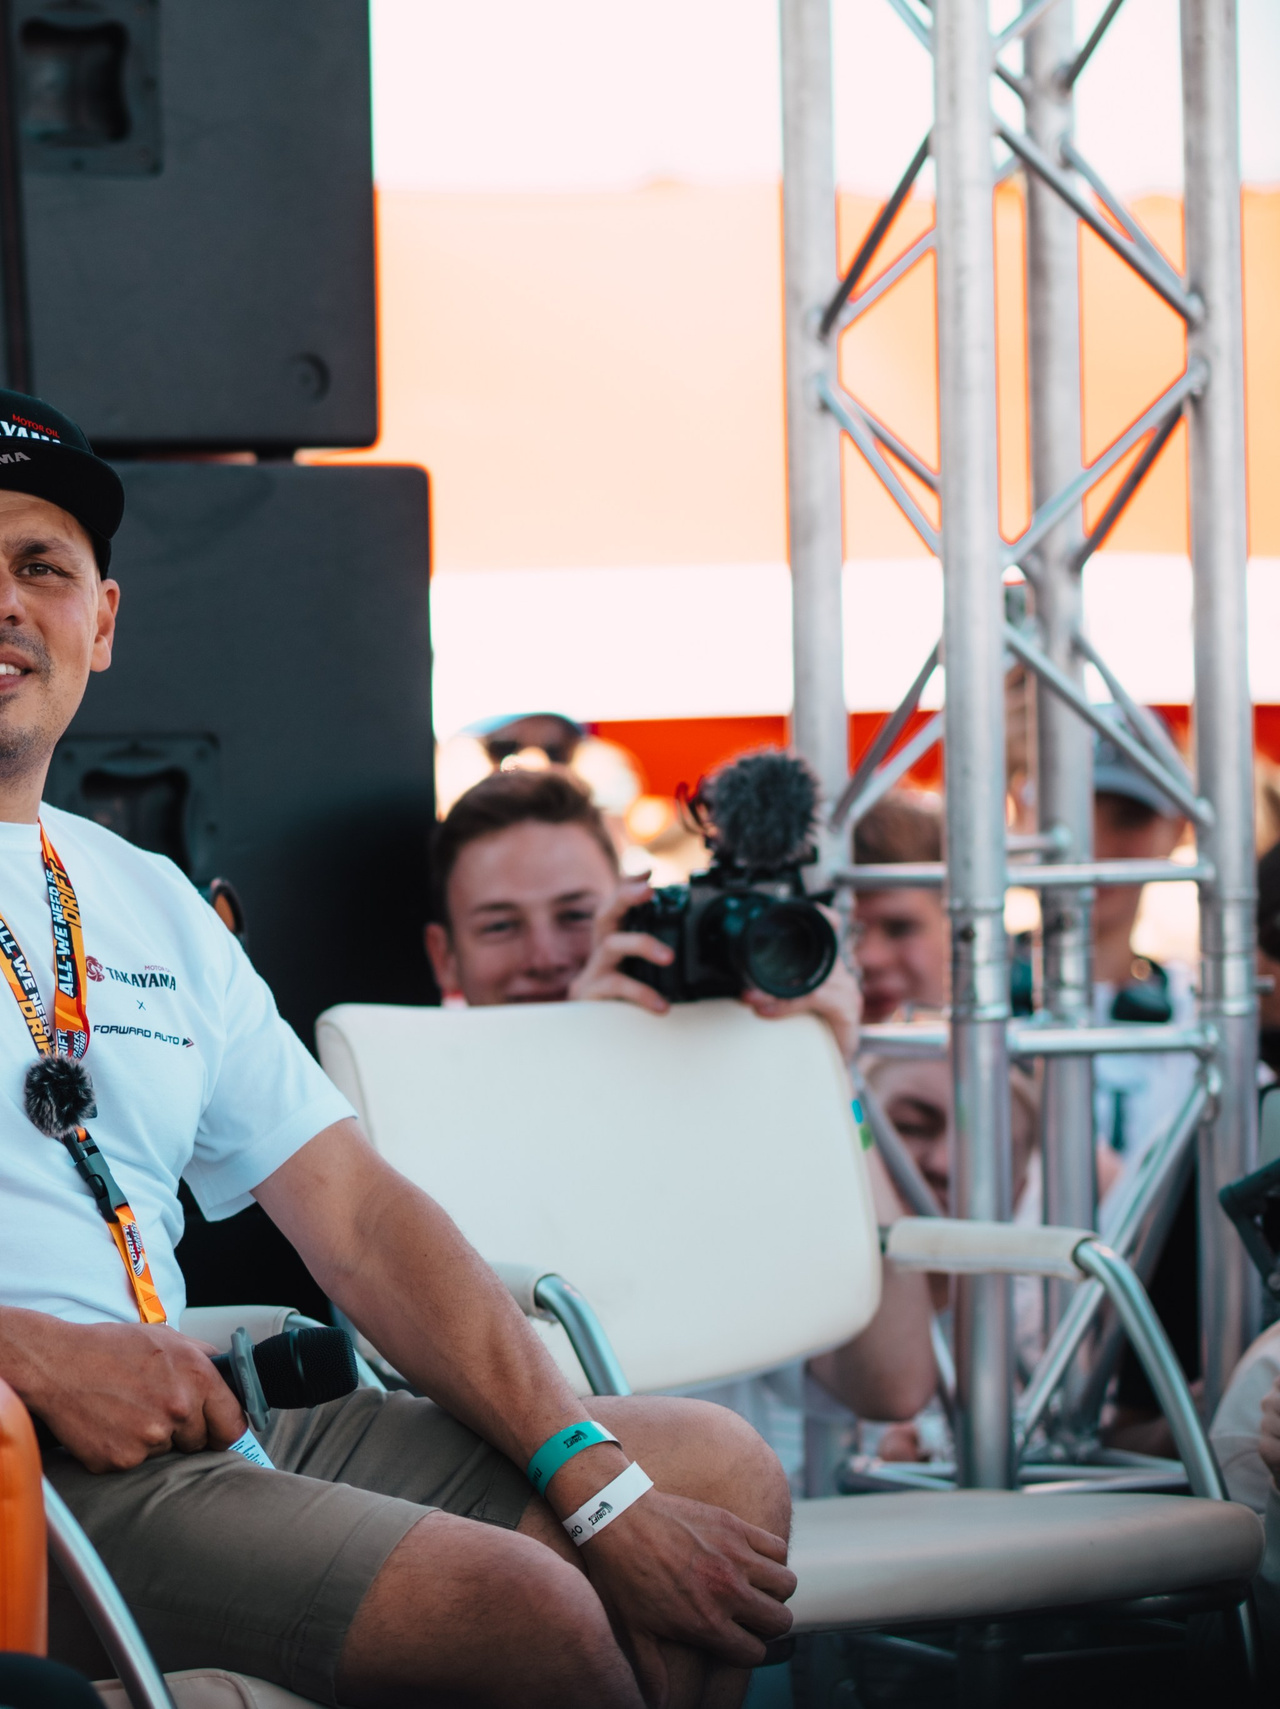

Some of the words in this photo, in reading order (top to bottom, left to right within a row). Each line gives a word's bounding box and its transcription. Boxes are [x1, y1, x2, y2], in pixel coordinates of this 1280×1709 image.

[12, 413, 44, 432] MOTOR
[45, 427, 60, 439] OIL
[49, 858, 81, 928] DRIFT
[49, 887, 67, 924] NEED
[19, 1000, 53, 1058] DRIF
[57, 1029, 68, 1056] RIFT
[93, 1025, 152, 1038] FORWARD
[154, 1031, 180, 1045] AUTO
[590, 1509, 607, 1526] DRIFT
